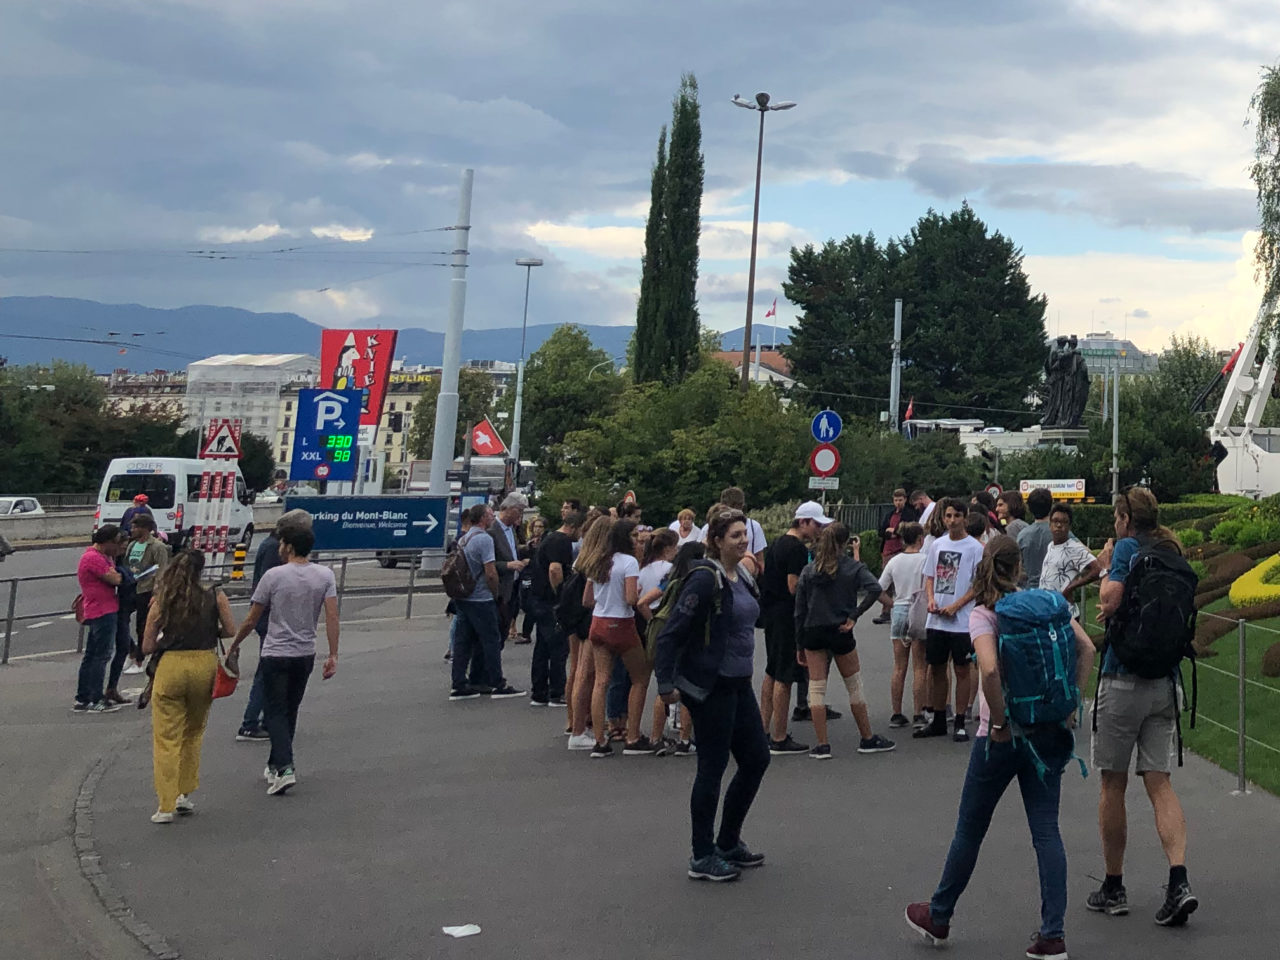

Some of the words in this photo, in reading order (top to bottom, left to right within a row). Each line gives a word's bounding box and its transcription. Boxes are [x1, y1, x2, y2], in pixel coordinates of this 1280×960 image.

[363, 334, 381, 386] KNIE
[316, 400, 342, 430] P
[302, 436, 308, 446] L
[327, 435, 353, 448] 330
[301, 451, 322, 461] XXL
[333, 450, 351, 462] 98
[309, 511, 340, 522] arking
[341, 511, 353, 520] du
[355, 511, 408, 520] Mont-Blanc
